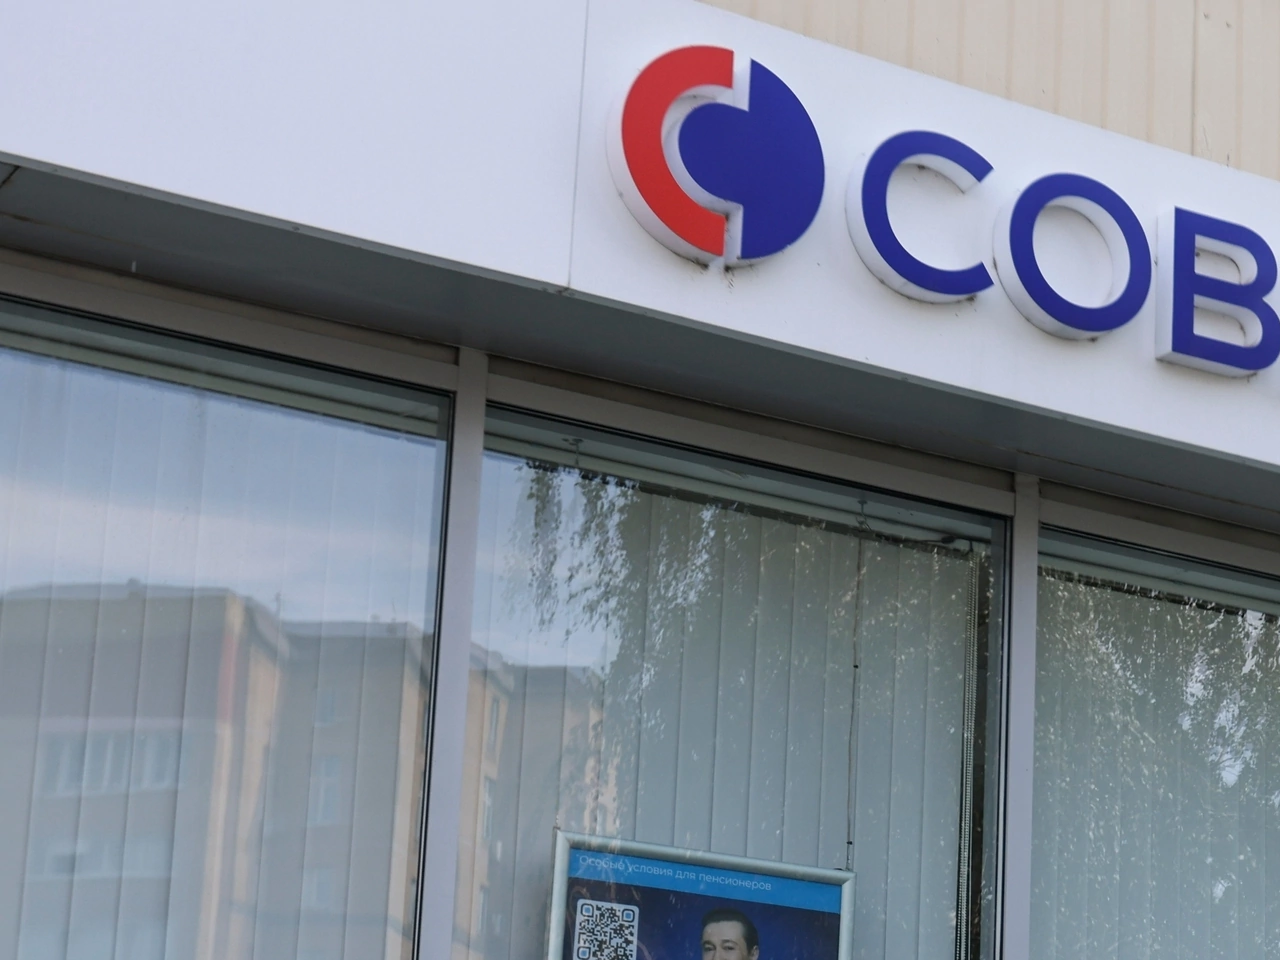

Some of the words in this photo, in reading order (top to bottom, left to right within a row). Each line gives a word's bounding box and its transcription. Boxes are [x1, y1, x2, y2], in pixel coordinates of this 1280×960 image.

[578, 854, 625, 870] Особые
[627, 861, 673, 877] условия
[675, 868, 696, 881] для
[698, 873, 772, 892] пенсионеров
